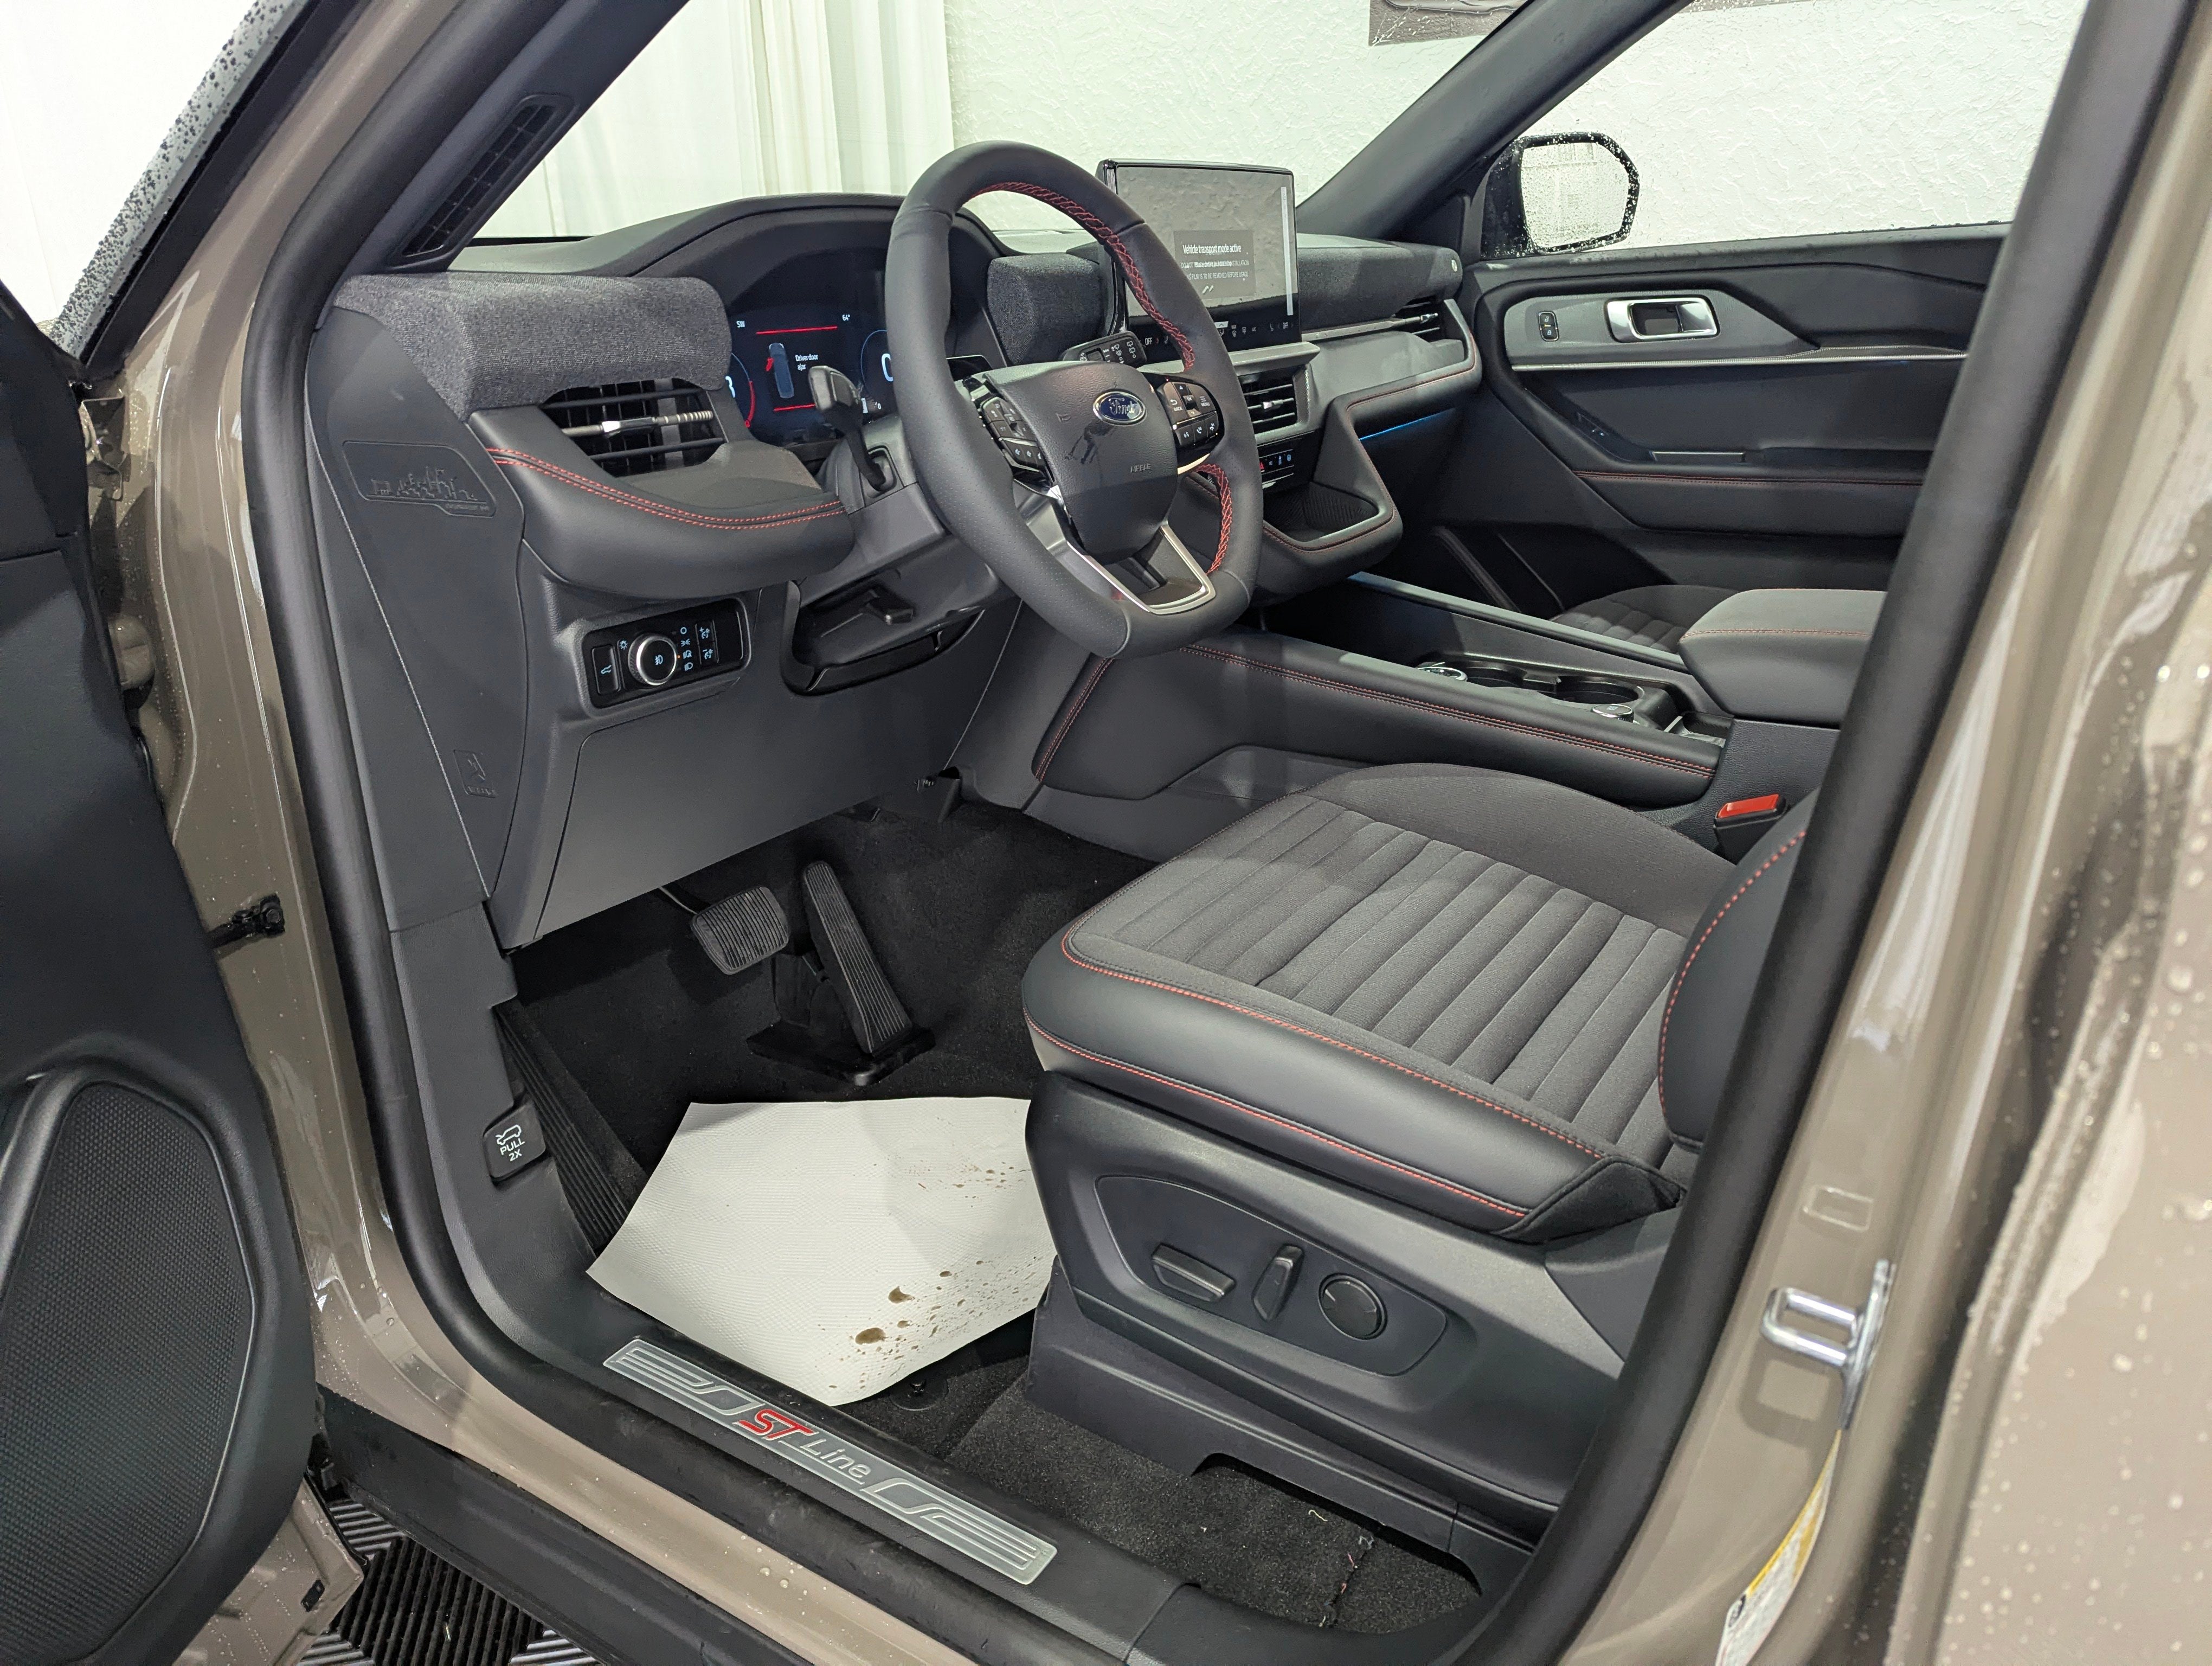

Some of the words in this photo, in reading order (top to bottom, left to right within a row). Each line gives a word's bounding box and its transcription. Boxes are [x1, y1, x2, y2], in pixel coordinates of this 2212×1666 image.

[1182, 244, 1198, 254] Vehicle
[1198, 244, 1218, 255] transport
[1218, 244, 1229, 253] mode
[1230, 244, 1242, 252] active
[1108, 397, 1136, 415] Ford
[500, 1138, 525, 1155] PULL
[509, 1149, 522, 1162] 2X
[735, 1409, 818, 1440] ST
[800, 1439, 871, 1478] Line
